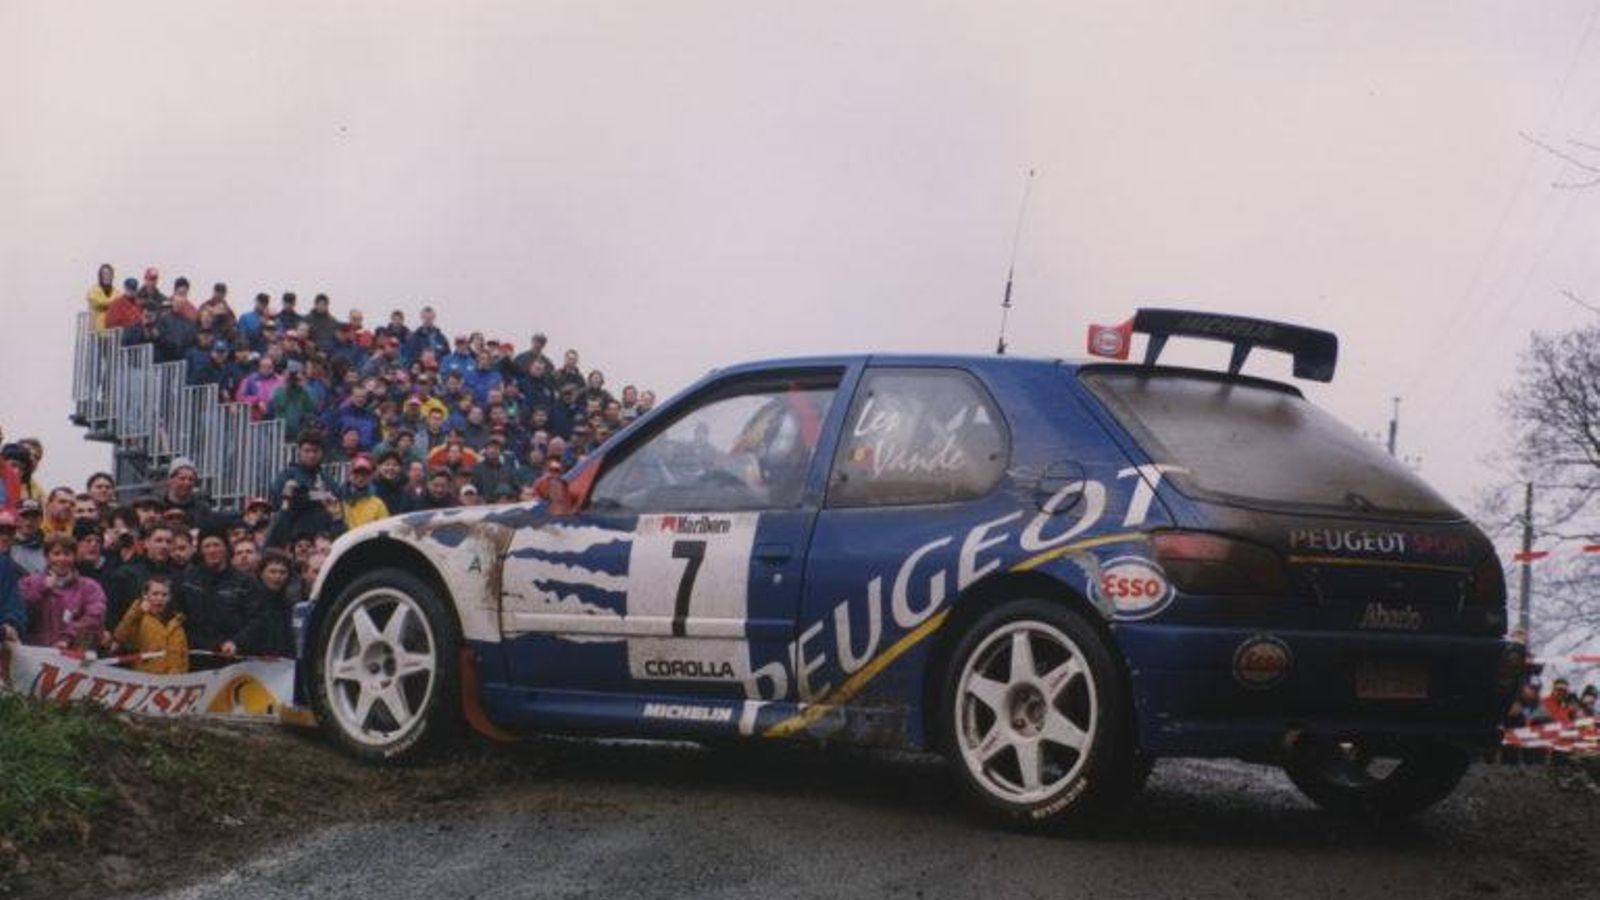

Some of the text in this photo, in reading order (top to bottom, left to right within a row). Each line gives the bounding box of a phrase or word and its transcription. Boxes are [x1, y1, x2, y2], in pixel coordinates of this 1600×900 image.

[1289, 528, 1405, 553] PEUGEOT
[468, 555, 481, 574] A
[672, 540, 707, 636] 7
[739, 463, 1190, 735] PEUGEOT
[645, 660, 734, 677] COROLLA
[36, 661, 207, 714] MEUSE
[643, 702, 732, 720] MICHELIN
